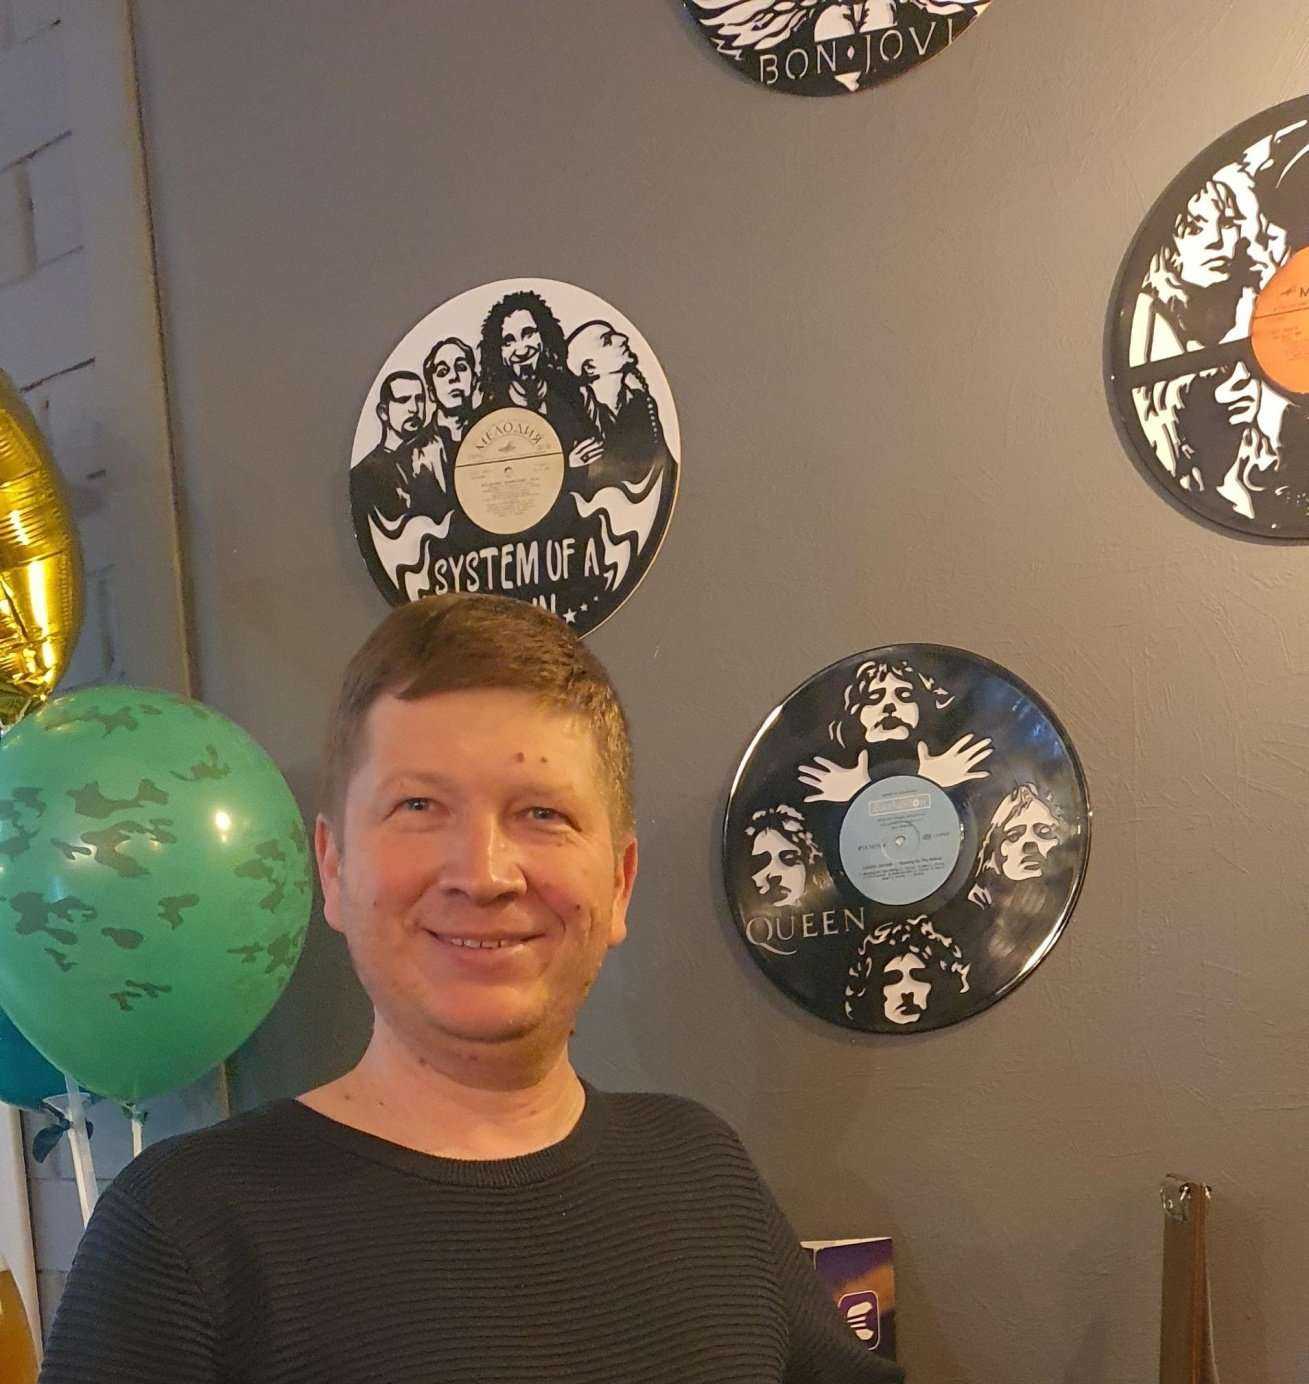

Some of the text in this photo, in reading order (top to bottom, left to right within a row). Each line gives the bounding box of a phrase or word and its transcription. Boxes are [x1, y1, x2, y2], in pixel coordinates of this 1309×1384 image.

[759, 18, 954, 84] BON JOVI
[434, 537, 600, 596] SYSTEM OF A
[745, 906, 866, 956] QUEEN
